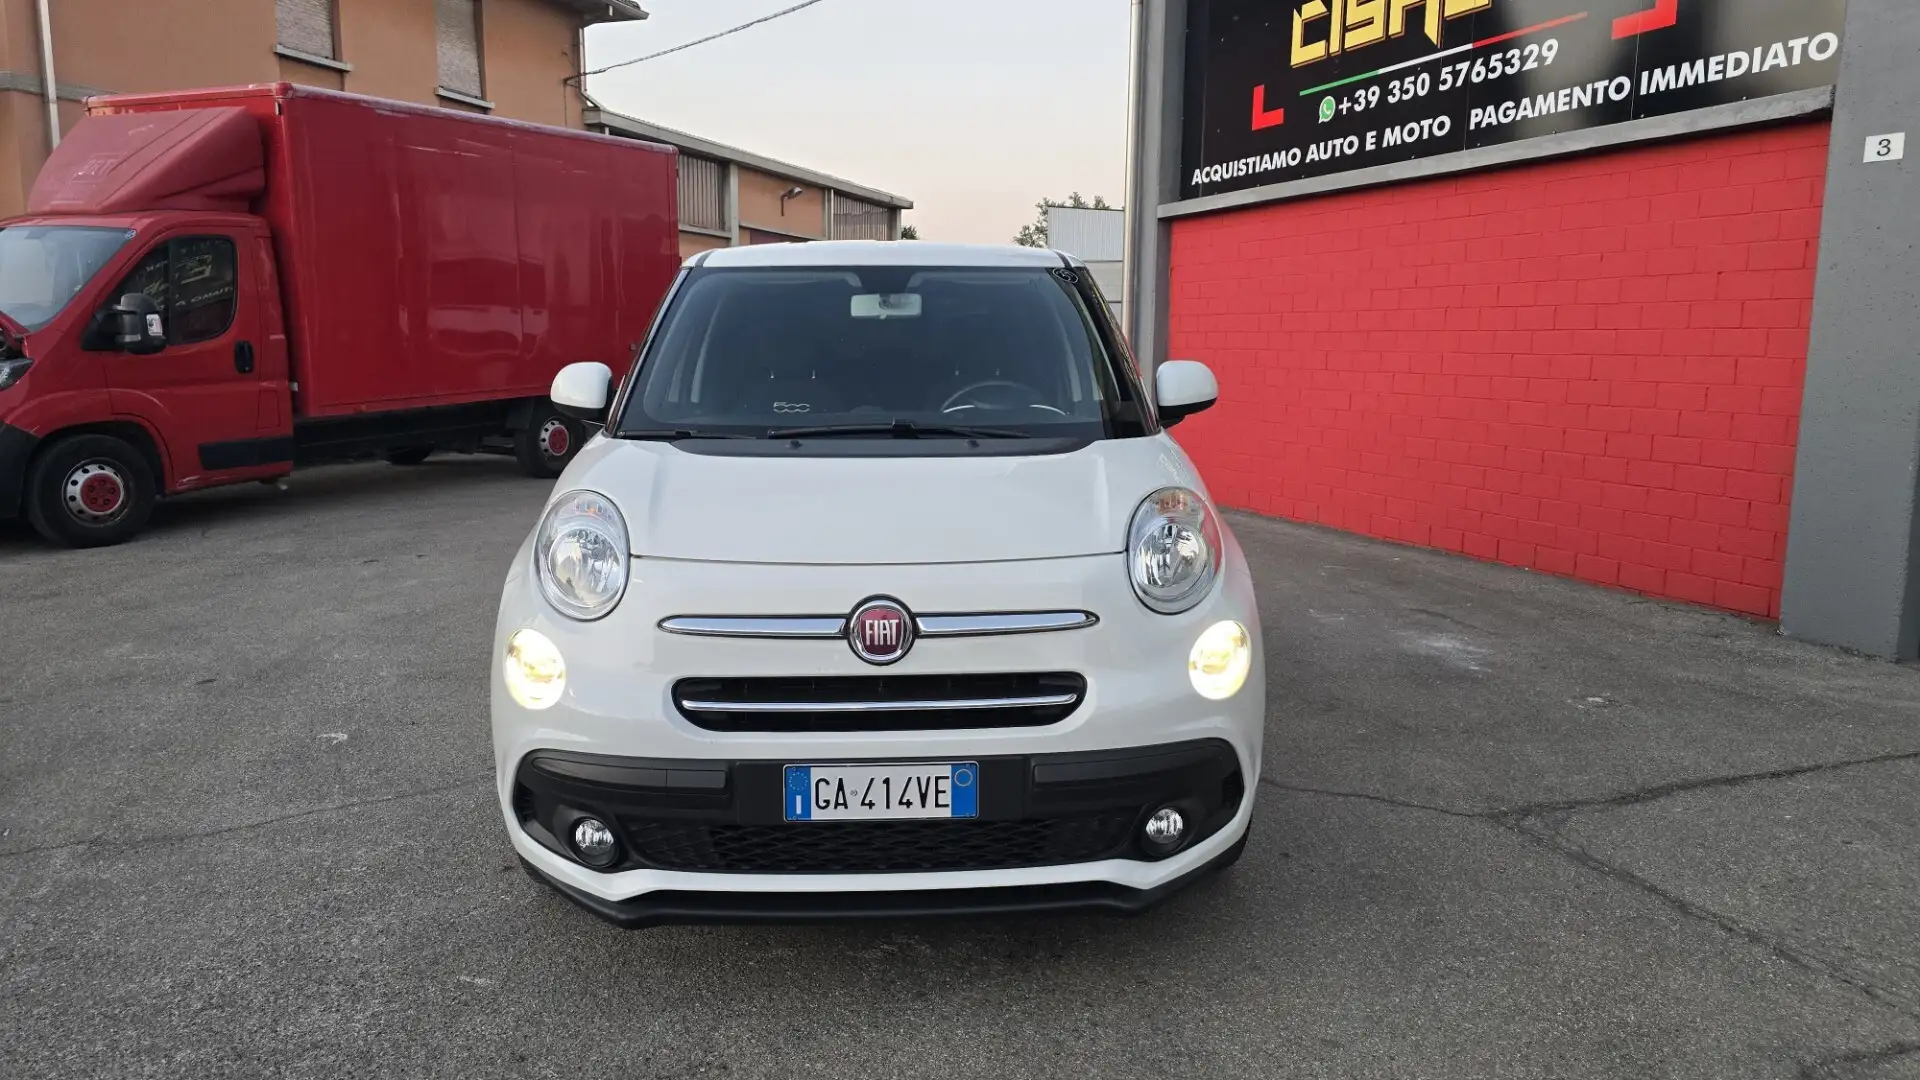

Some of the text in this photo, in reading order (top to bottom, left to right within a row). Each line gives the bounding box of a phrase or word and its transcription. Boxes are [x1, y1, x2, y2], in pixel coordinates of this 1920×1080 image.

[1338, 38, 1559, 115] +39 350 5765329
[1191, 31, 1839, 185] ACQUISTIAMO AUTO E MOTO PAGAMENTO IMMEDIATO
[1876, 138, 1891, 157] 3
[865, 619, 900, 646] FIAT
